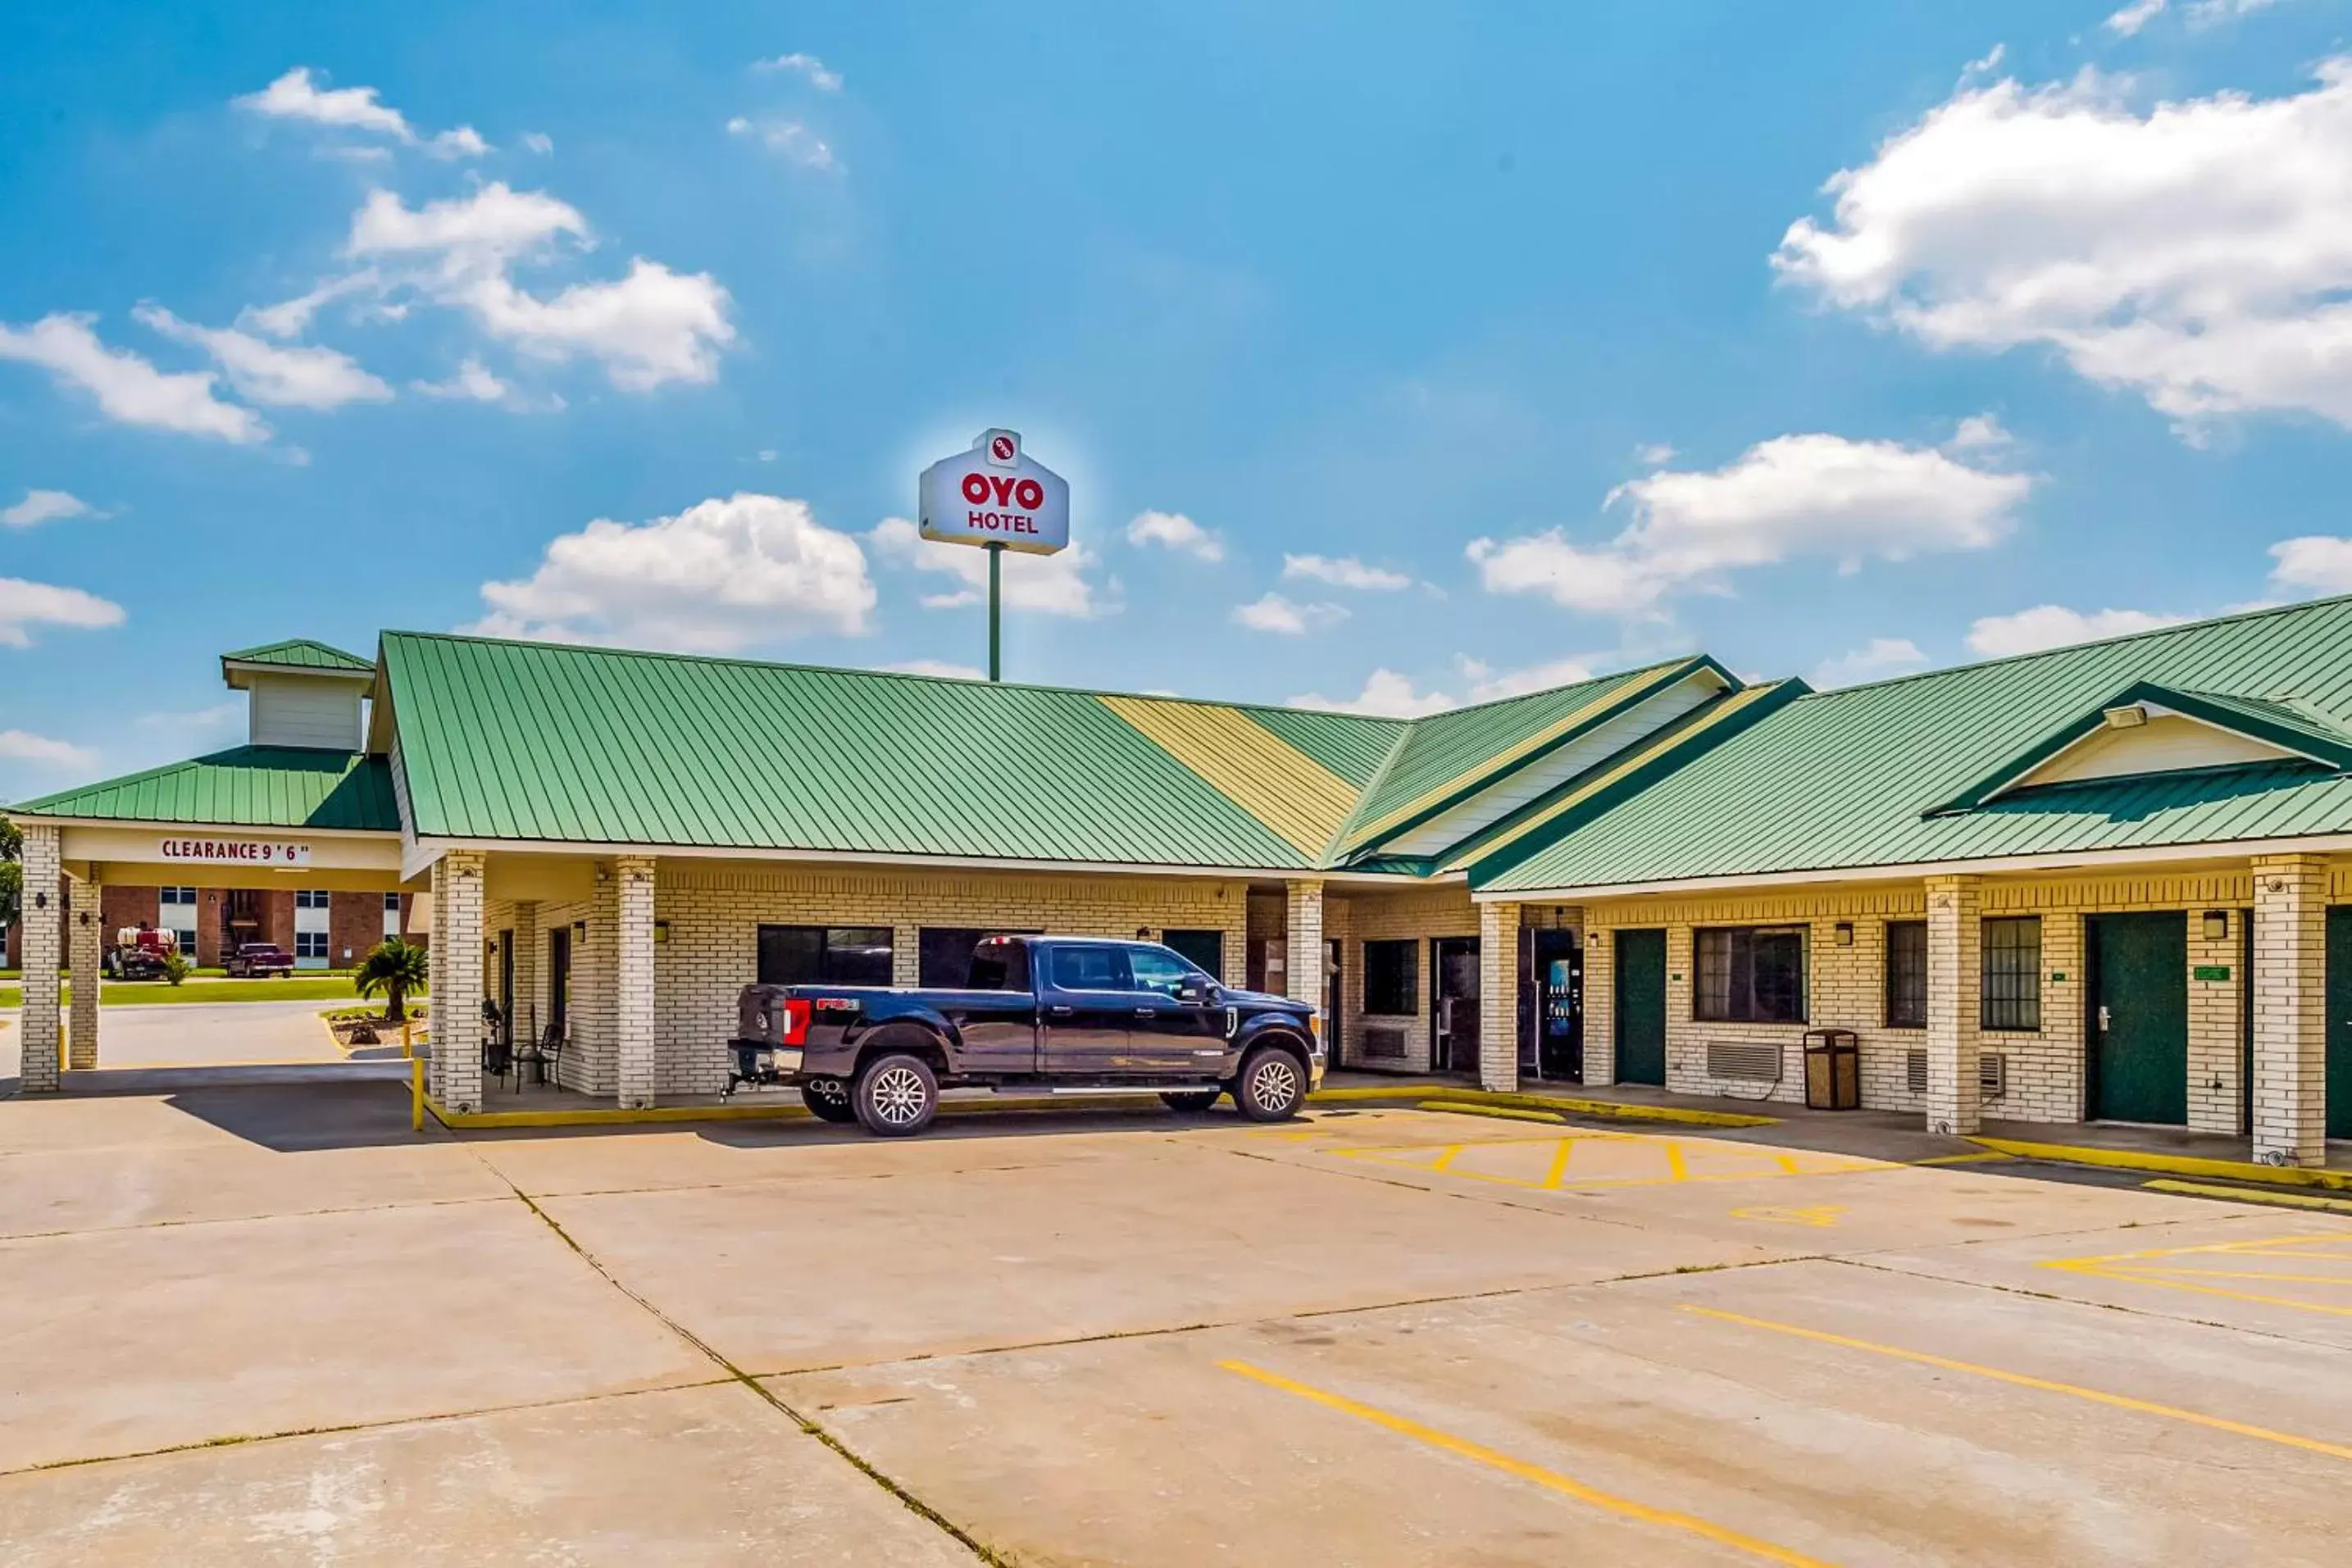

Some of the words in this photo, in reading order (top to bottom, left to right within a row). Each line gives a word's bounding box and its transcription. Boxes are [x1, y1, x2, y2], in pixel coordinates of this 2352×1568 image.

[962, 473, 1044, 510] OYO
[968, 511, 1039, 534] HOTEL
[162, 840, 257, 859] CLEARANCE
